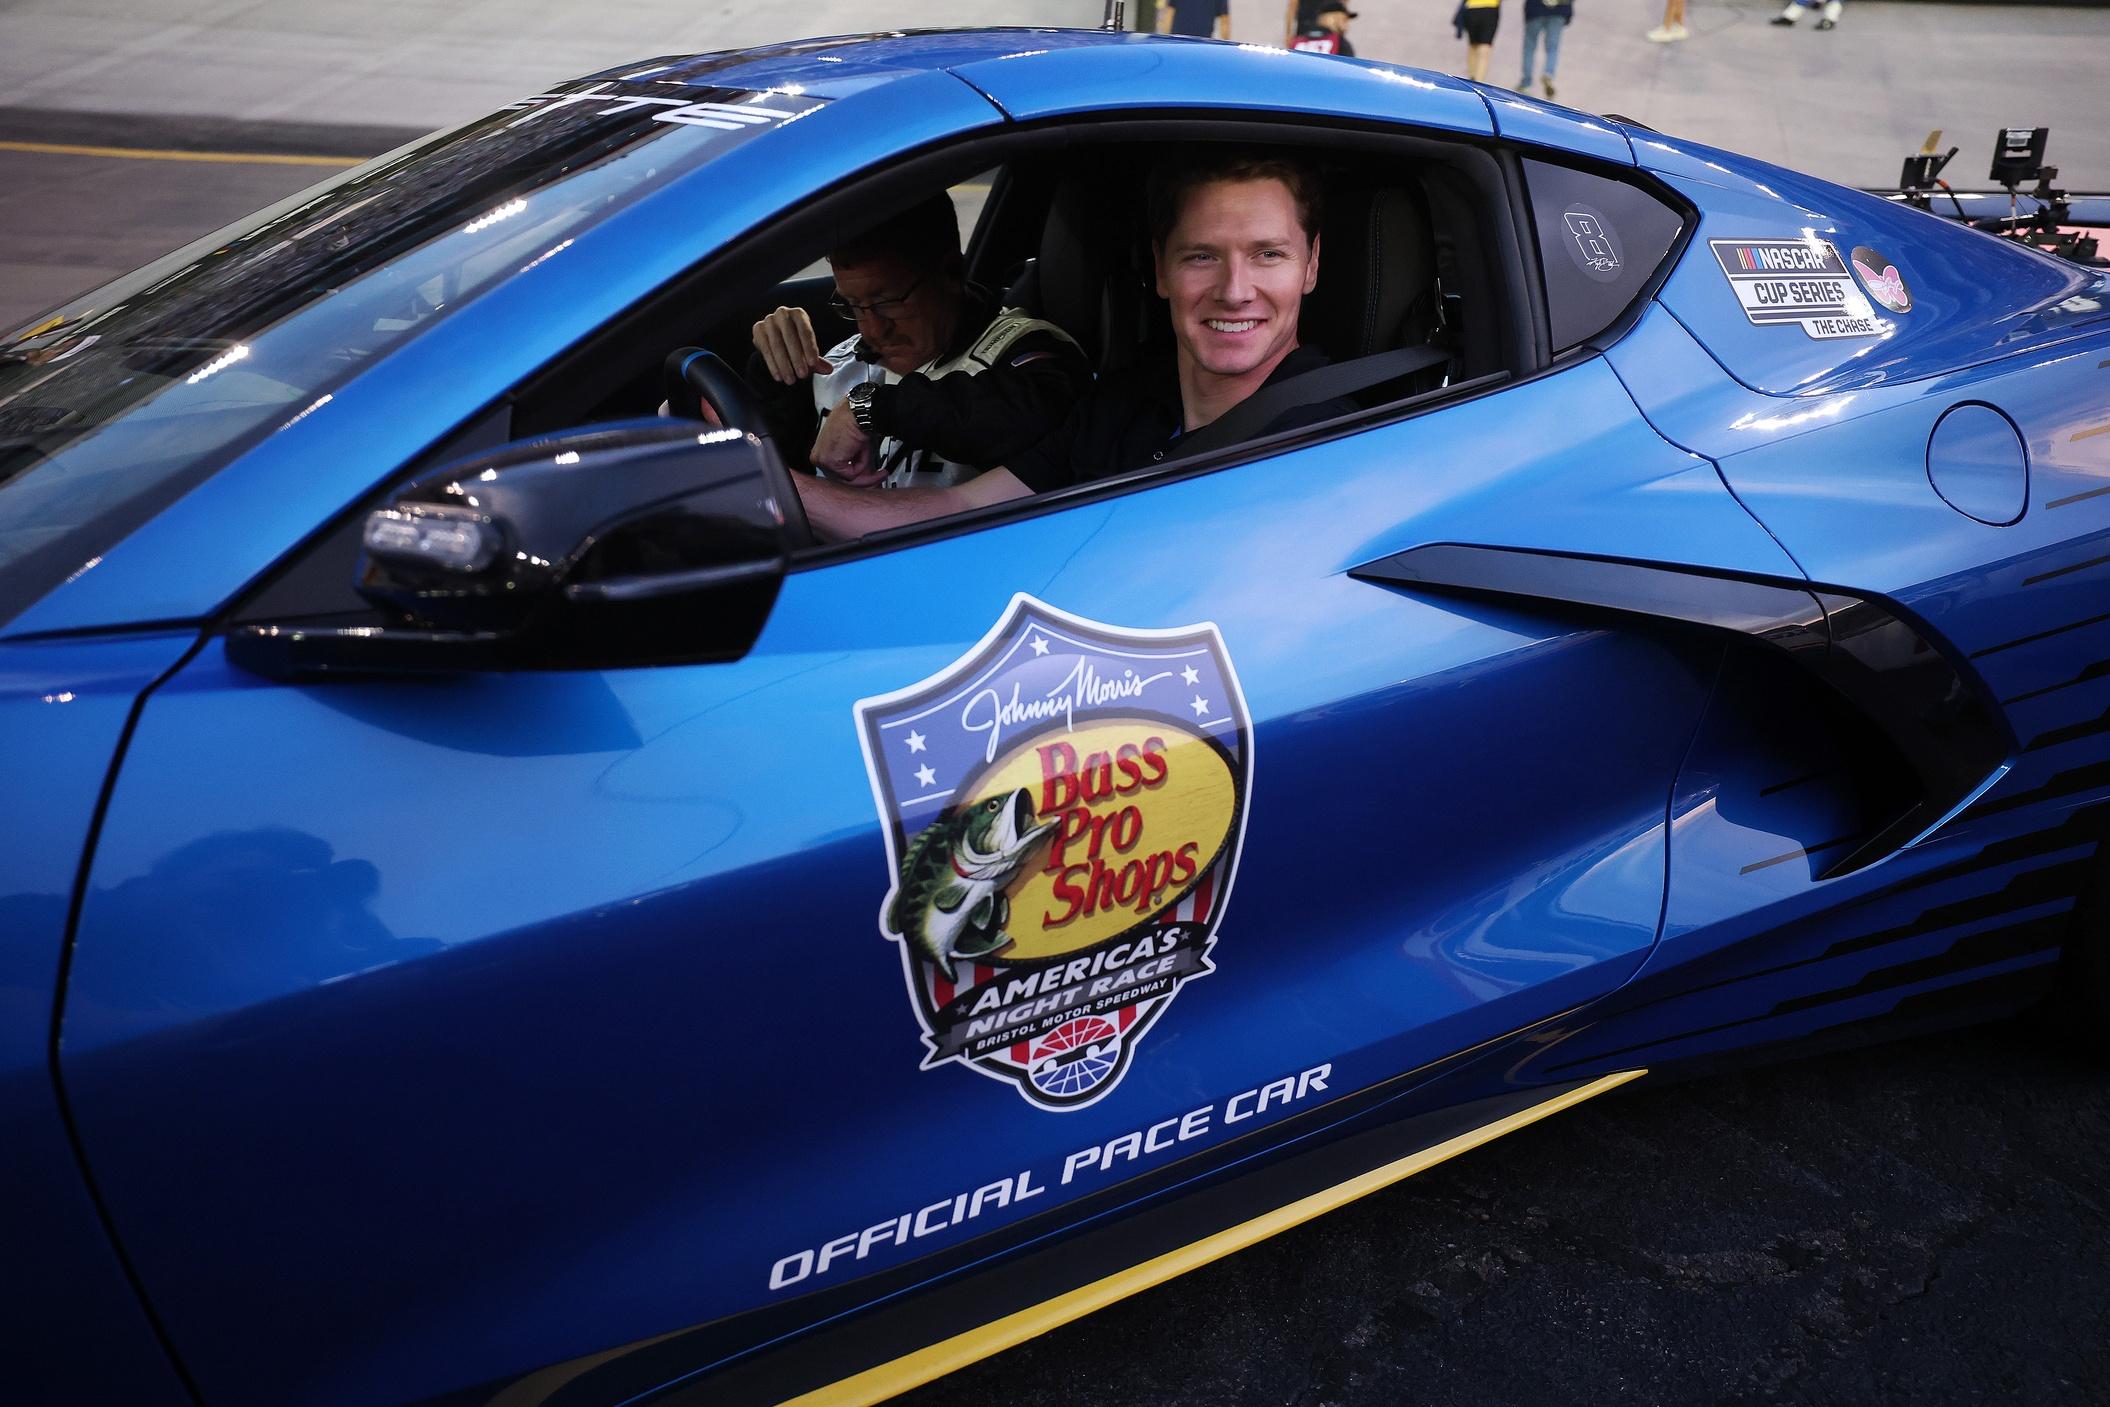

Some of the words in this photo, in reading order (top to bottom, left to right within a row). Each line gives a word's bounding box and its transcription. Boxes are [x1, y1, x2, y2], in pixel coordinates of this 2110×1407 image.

[1753, 282, 1788, 305] CUP
[1790, 281, 1846, 304] SERIES
[1758, 247, 1827, 270] NASCAR
[1812, 319, 1837, 335] THE
[1836, 318, 1875, 334] CHASE
[961, 682, 1073, 764] Johnny
[1046, 654, 1173, 707] Morris
[1035, 736, 1168, 817] Bass
[1042, 804, 1145, 873] Pro
[1042, 841, 1200, 929] Shops
[965, 986, 1083, 1039] NIGHT
[1088, 953, 1177, 998] RACE
[968, 926, 1182, 1016] AMERICA'S
[976, 1022, 1037, 1051] BRISTOL
[1041, 1004, 1092, 1028] MOTOR
[1095, 978, 1169, 1011] SPEEDWAY
[768, 1169, 1045, 1291] OFFICIAL
[1060, 1105, 1214, 1185] PACE
[1223, 1062, 1333, 1125] CAR
